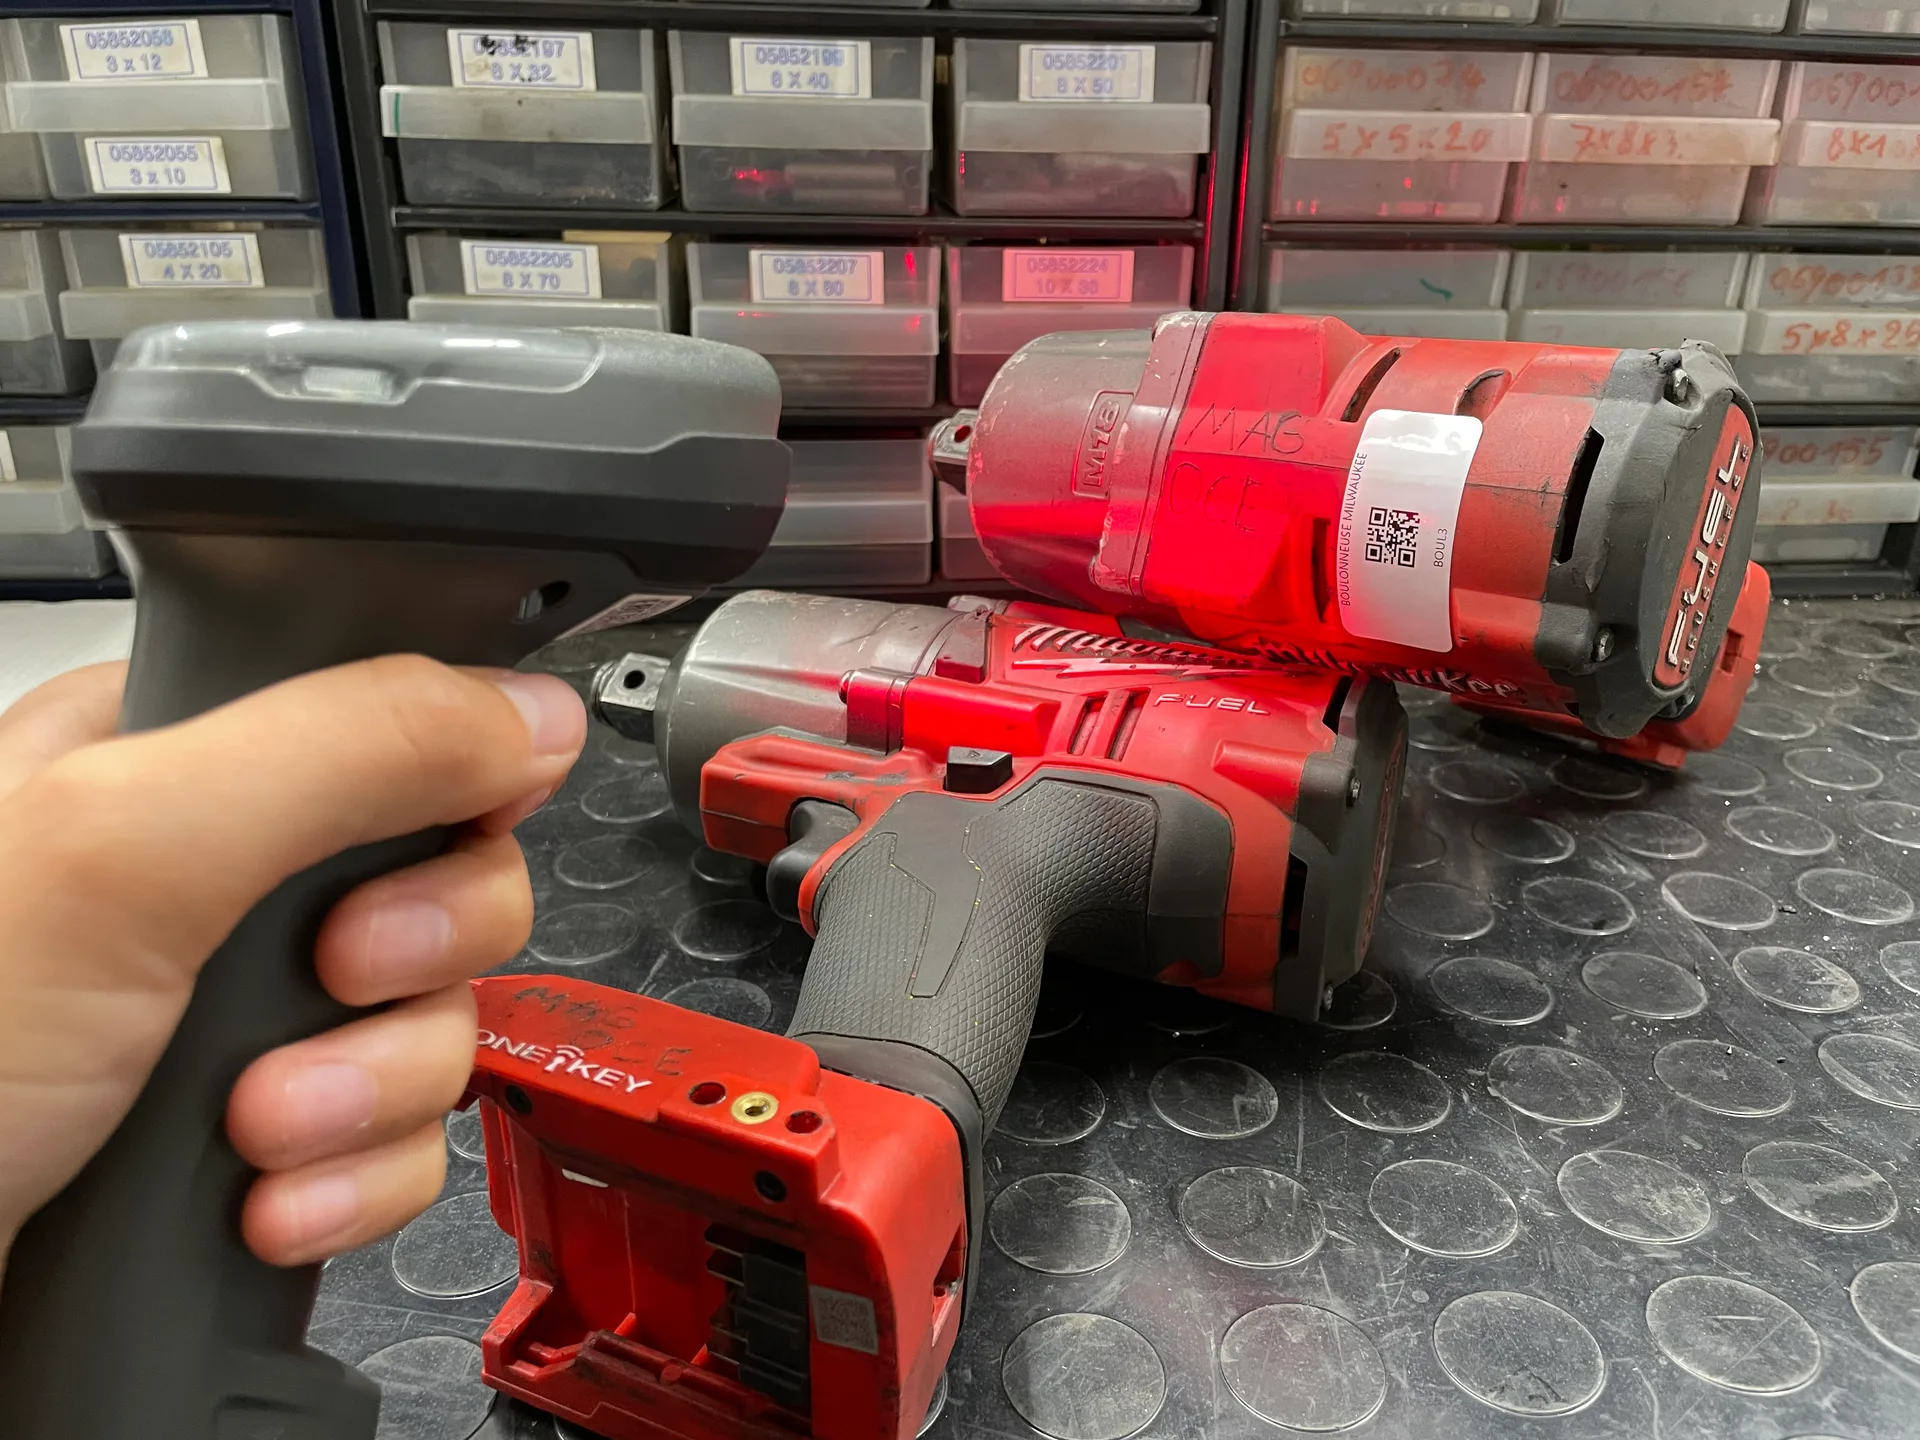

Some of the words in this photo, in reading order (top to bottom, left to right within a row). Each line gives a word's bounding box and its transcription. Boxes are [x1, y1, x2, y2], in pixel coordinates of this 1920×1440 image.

[106, 54, 118, 73] 3
[140, 53, 162, 70] 12
[1043, 52, 1127, 71] 05852201
[807, 71, 830, 89] 40
[1092, 77, 1114, 94] 50
[109, 144, 198, 162] 05852055
[130, 167, 142, 185] 3
[164, 167, 186, 185] 10
[144, 241, 233, 258] 05852105
[486, 249, 573, 269] 05852205
[164, 263, 175, 280] 4
[199, 263, 220, 280] 20
[774, 257, 858, 274] 05852207
[1027, 257, 1108, 274] 05852224
[538, 272, 560, 290] 70
[1036, 278, 1056, 294] 10
[1184, 402, 1304, 454] MAG
[1081, 400, 1121, 489] M18
[1343, 452, 1368, 521] MILWAUKEE
[1433, 528, 1448, 568] BOUL3
[1666, 433, 1741, 668] FUEL
[1339, 523, 1352, 607] BOULONNEUSE
[1152, 693, 1272, 716] FUEL
[477, 1028, 552, 1065] ONE
[565, 1057, 653, 1093] KEY
